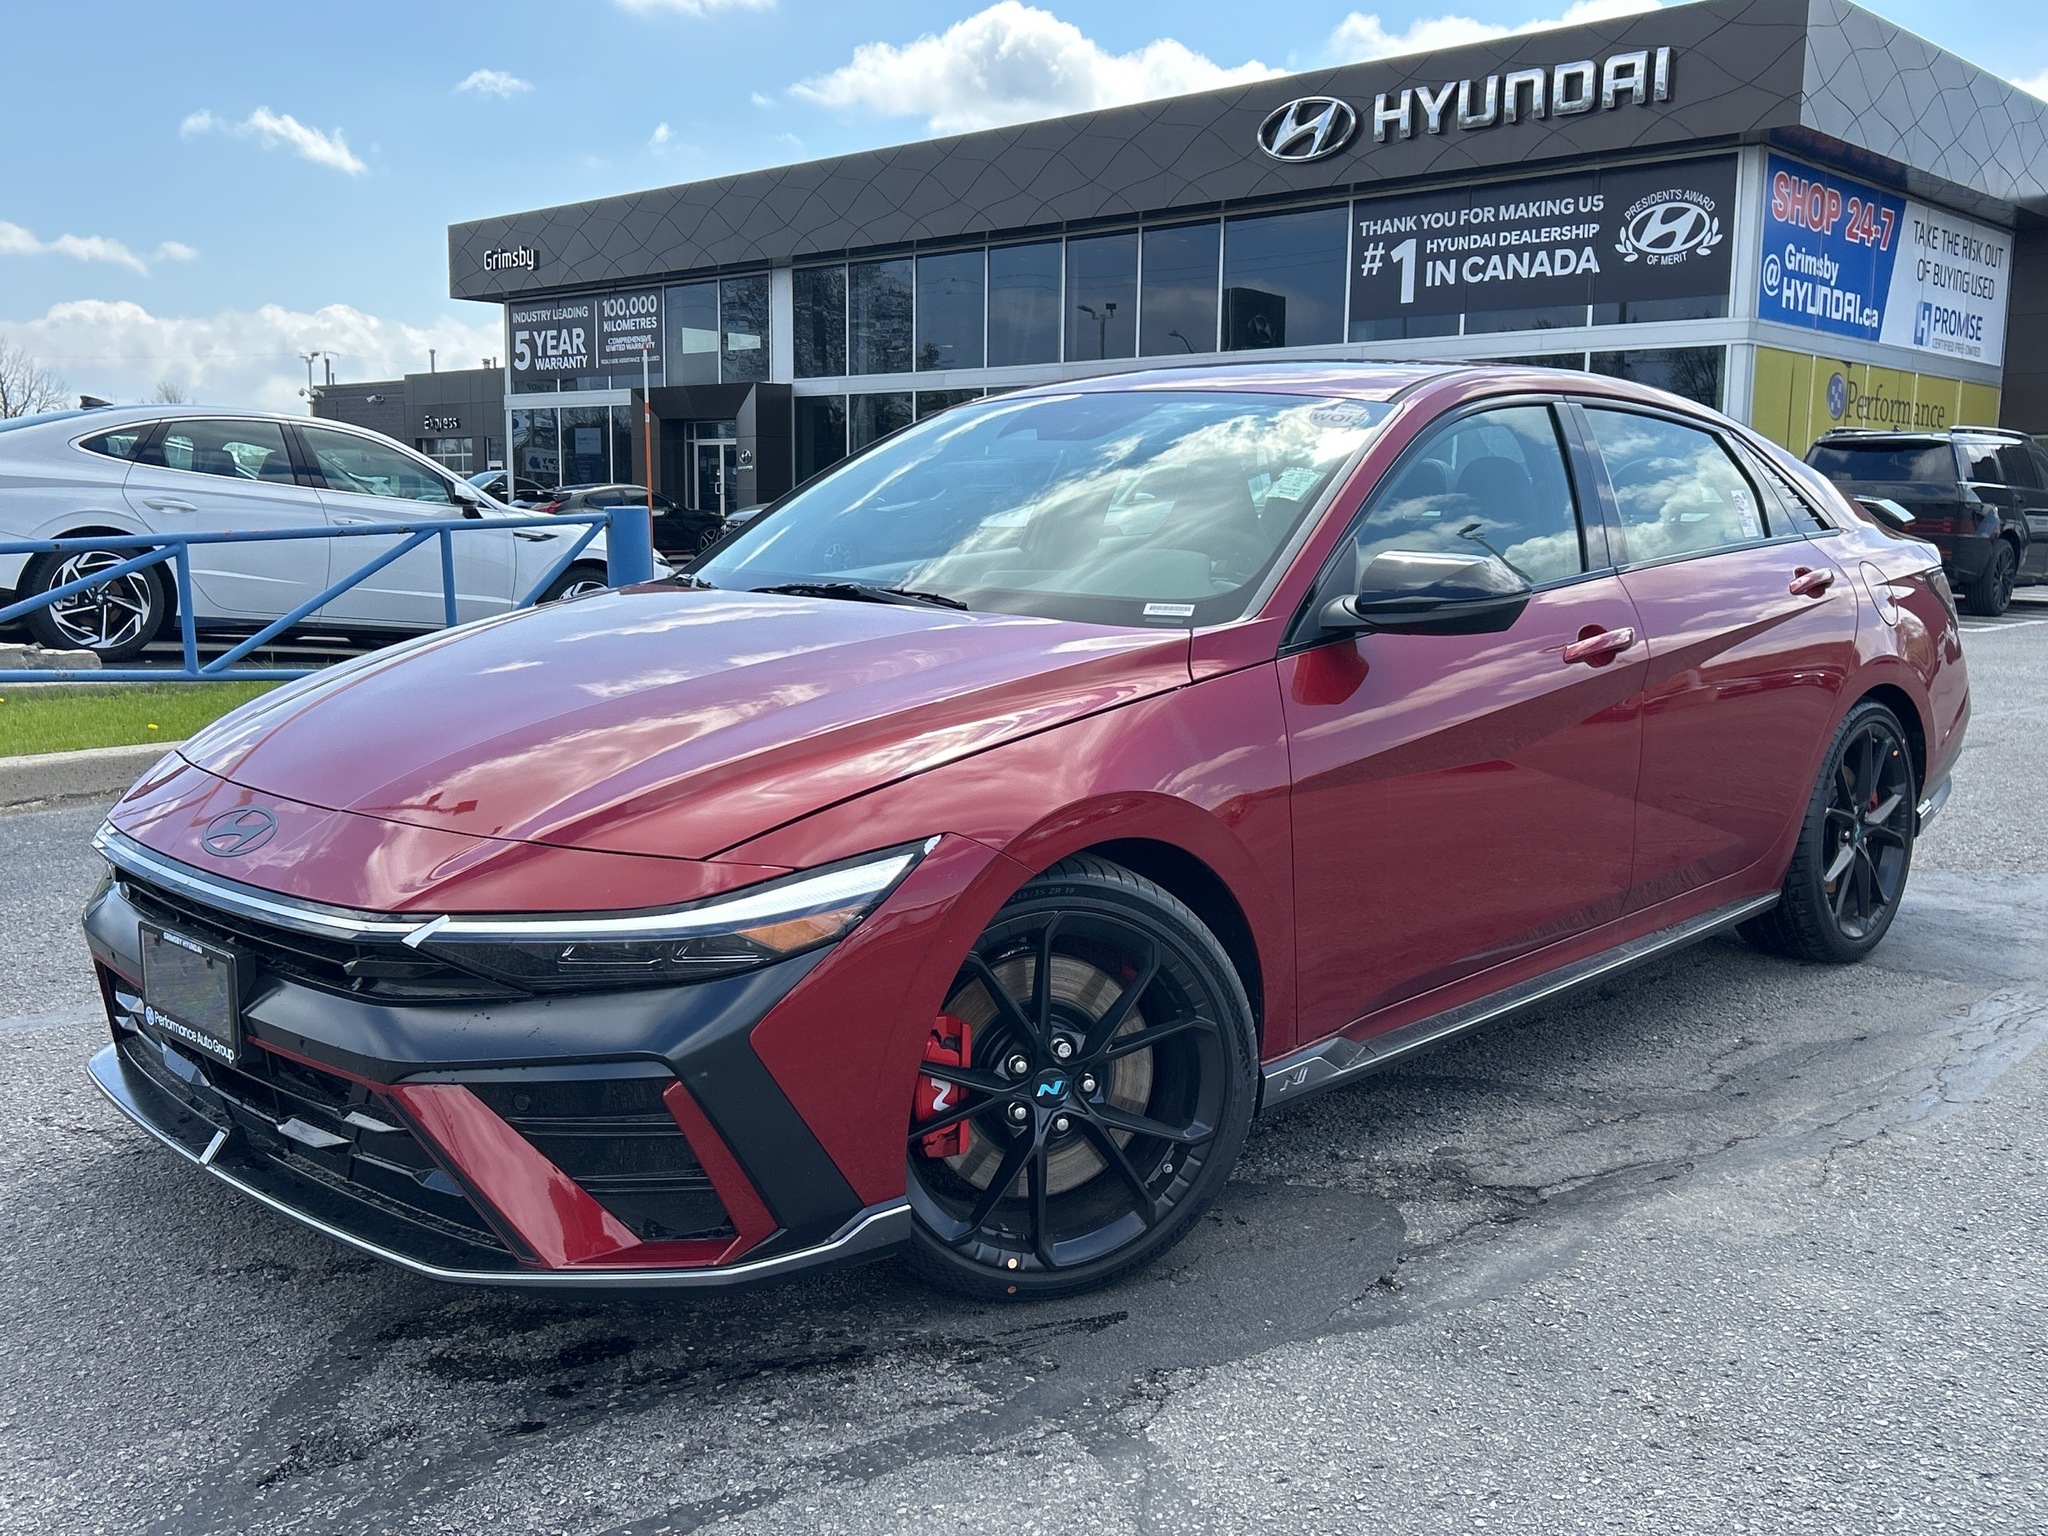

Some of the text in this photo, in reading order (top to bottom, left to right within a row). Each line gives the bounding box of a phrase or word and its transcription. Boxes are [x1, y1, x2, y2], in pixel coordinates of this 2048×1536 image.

[1373, 46, 1671, 143] HYUNDAI
[1359, 194, 1604, 237] THANK YOU FOR MAKING US
[1683, 190, 1716, 212] AWARD
[1772, 171, 1842, 235] SHOP
[483, 245, 534, 271] Grimsby
[1426, 223, 1600, 254] HYUNDAI DEALERSHIP
[1647, 251, 1688, 265] OF MERIT
[1914, 220, 2004, 269] TAKE THE RISK OUT
[1425, 246, 1601, 287] IN CANADA
[1785, 243, 1840, 286] Grimsby
[1917, 258, 1995, 300] OF BUYING USED
[512, 306, 589, 324] INDUSTRY LEADING
[602, 294, 658, 319] 100,000
[1781, 276, 1879, 329] HYUNDAI.ca
[603, 316, 658, 333] KILOMETRES
[1933, 306, 1983, 342] PROMISE
[513, 327, 586, 371] 5 YEAR
[534, 355, 589, 371] WARRANTY
[626, 341, 656, 350] WARRNTY
[1846, 381, 1945, 429] Performance
[154, 1010, 235, 1064] Performance Auto Group
